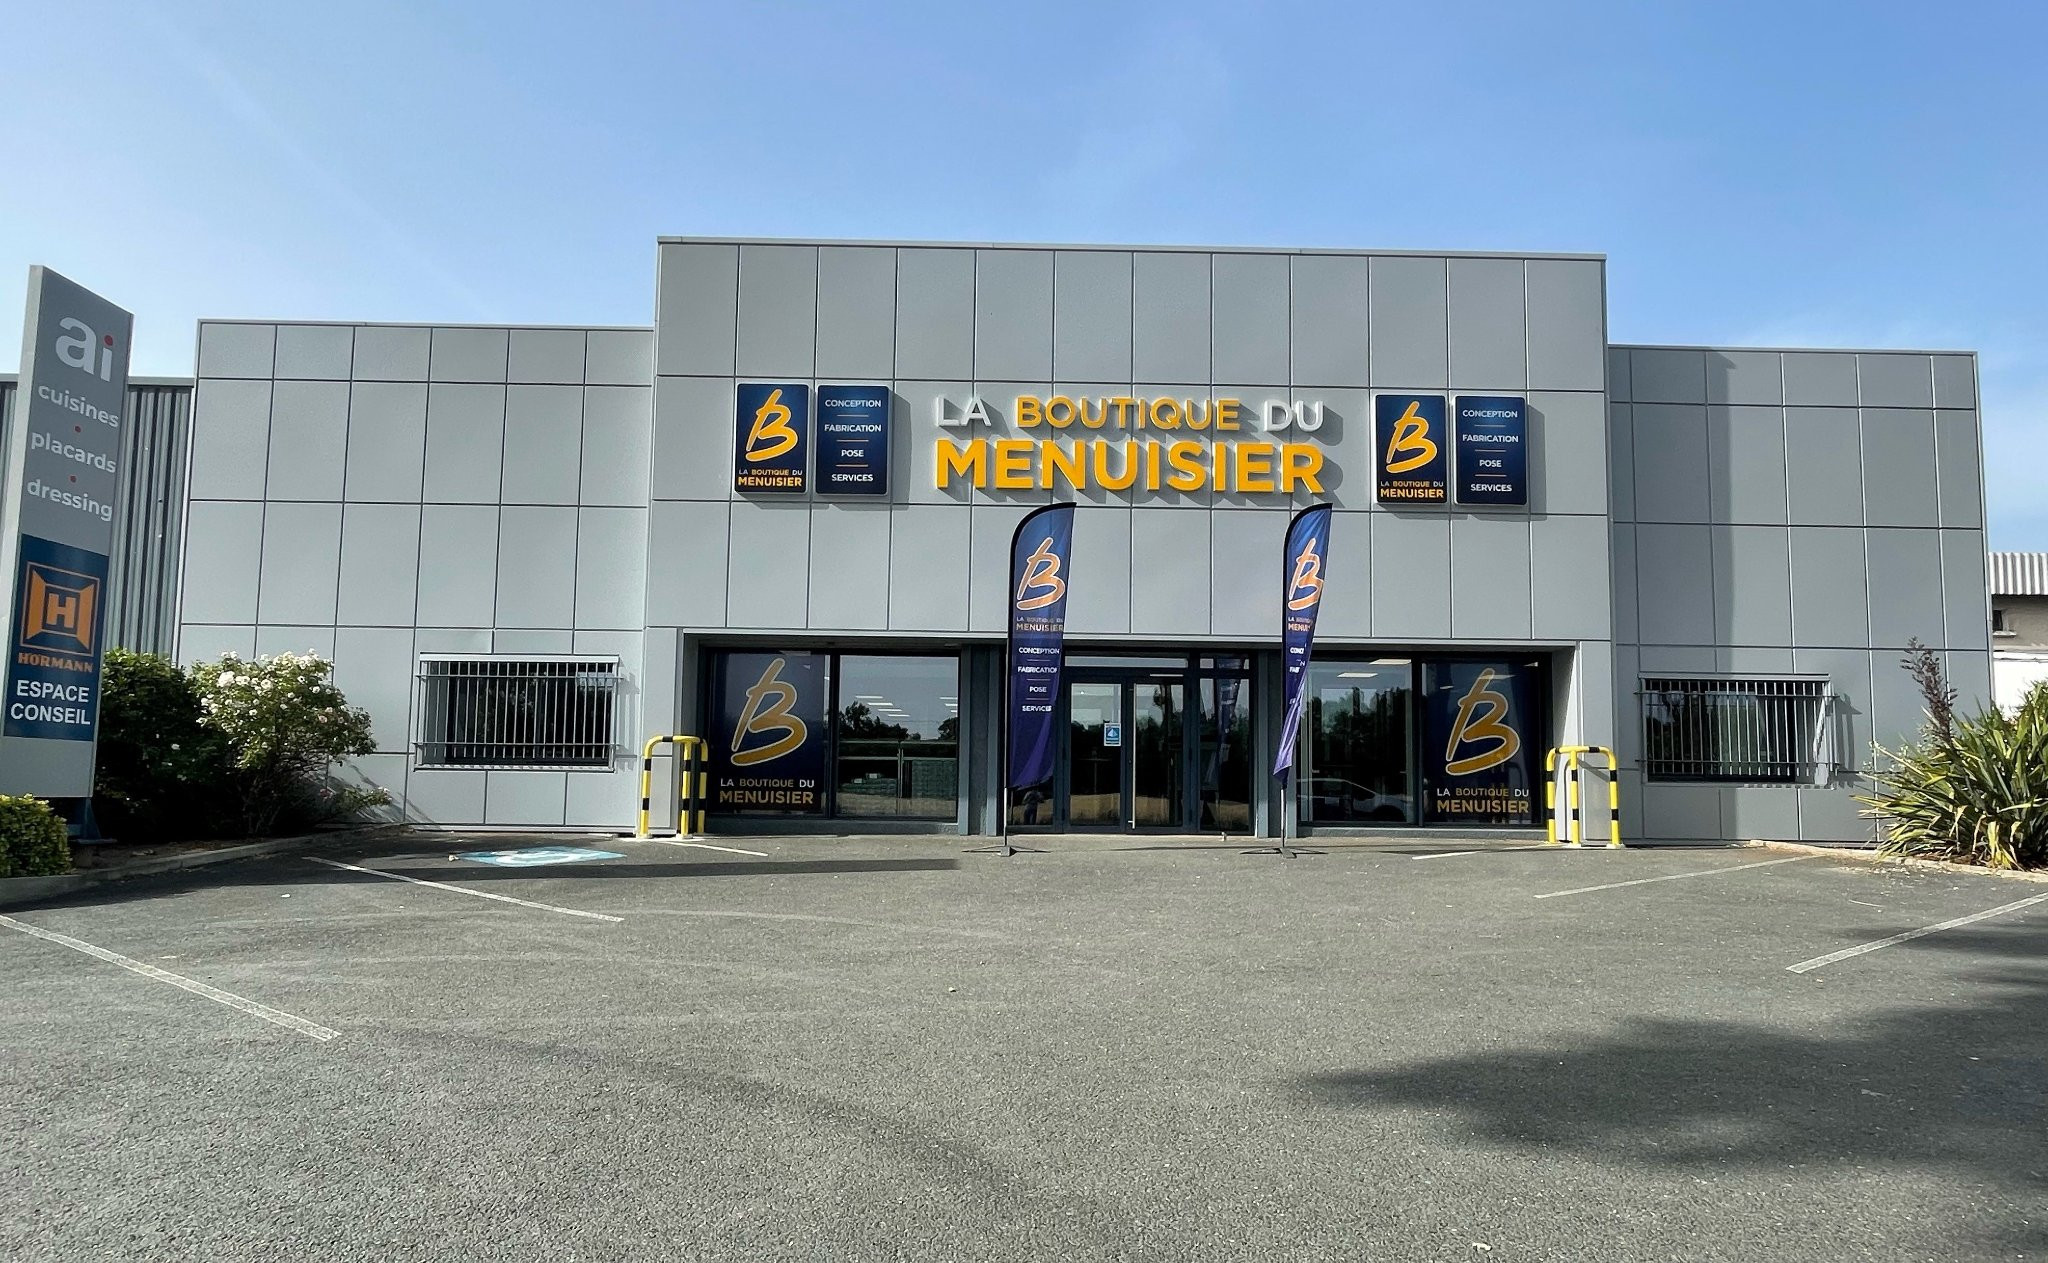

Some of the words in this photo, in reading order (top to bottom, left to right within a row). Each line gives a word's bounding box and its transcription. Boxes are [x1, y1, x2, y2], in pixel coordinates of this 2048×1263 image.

[55, 316, 114, 382] ai
[38, 385, 119, 428] cuisines
[825, 400, 881, 408] CONCEPTION
[936, 397, 992, 428] LA
[1016, 397, 1240, 431] BOUTIQUE
[1263, 400, 1324, 432] DU
[1462, 410, 1518, 418] CONCEPTION
[824, 424, 882, 432] FABRICATION
[1462, 434, 1519, 443] FABRICATION
[30, 431, 117, 474] placards
[841, 450, 864, 458] POSE
[935, 438, 1324, 494] MENUISIER
[1479, 460, 1502, 468] POSE
[738, 476, 803, 487] MENUISIER
[831, 473, 874, 482] SERVICES
[1470, 483, 1513, 492] SERVICES
[1380, 488, 1444, 499] MENUISIER
[27, 478, 113, 523] dressing
[1016, 622, 1064, 632] MENUISIER
[16, 679, 90, 703] ESPACE
[10, 702, 91, 725] CONSEIL
[720, 778, 734, 787] LA
[739, 778, 794, 788] BOUTIQUE
[799, 779, 815, 788] DU
[720, 790, 814, 804] MENUISIER
[1437, 788, 1451, 797] LA
[1455, 788, 1509, 797] BOUTIQUE
[1514, 788, 1529, 797] DU
[1437, 799, 1529, 814] MENUISIER
